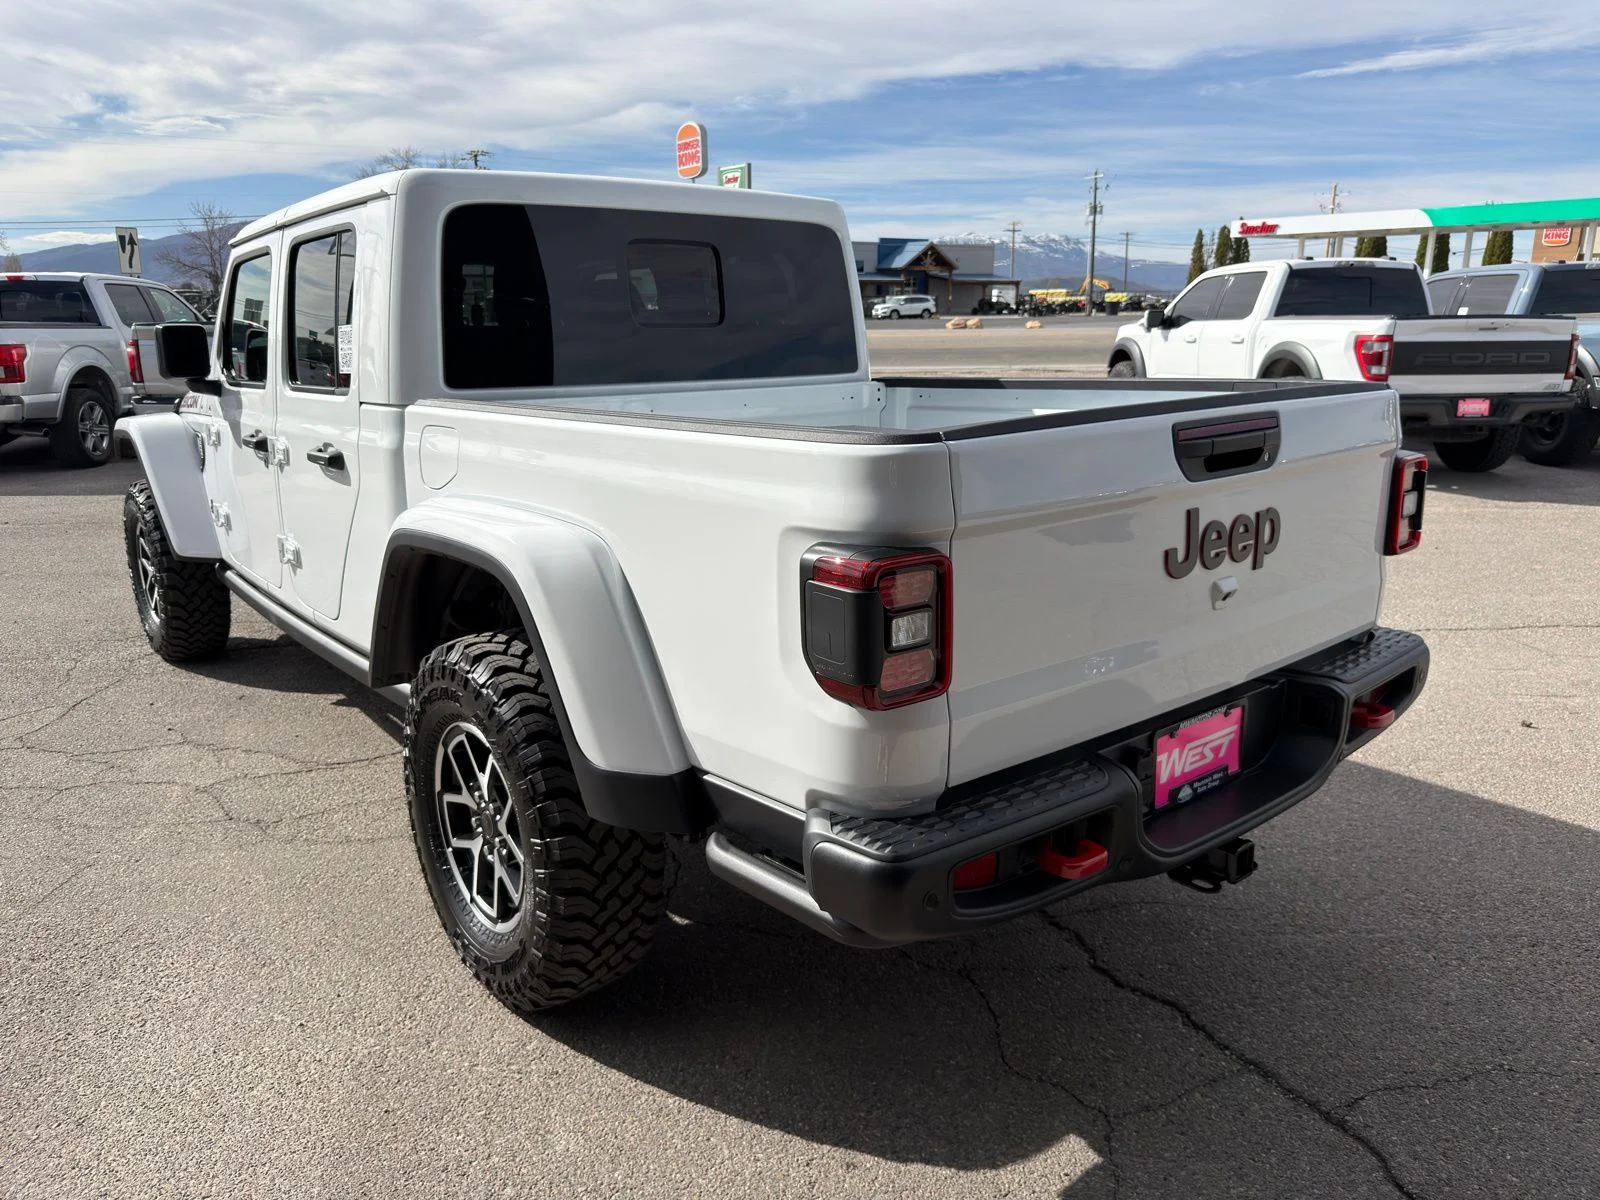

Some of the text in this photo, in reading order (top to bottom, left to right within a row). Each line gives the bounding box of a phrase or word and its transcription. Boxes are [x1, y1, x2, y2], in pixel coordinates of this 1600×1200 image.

[678, 150, 700, 168] KING
[1238, 221, 1279, 235] Sinclair
[1544, 231, 1569, 239] KING
[1414, 351, 1552, 367] FORD
[1164, 507, 1281, 579] Jeep
[1157, 725, 1238, 784] WEST
